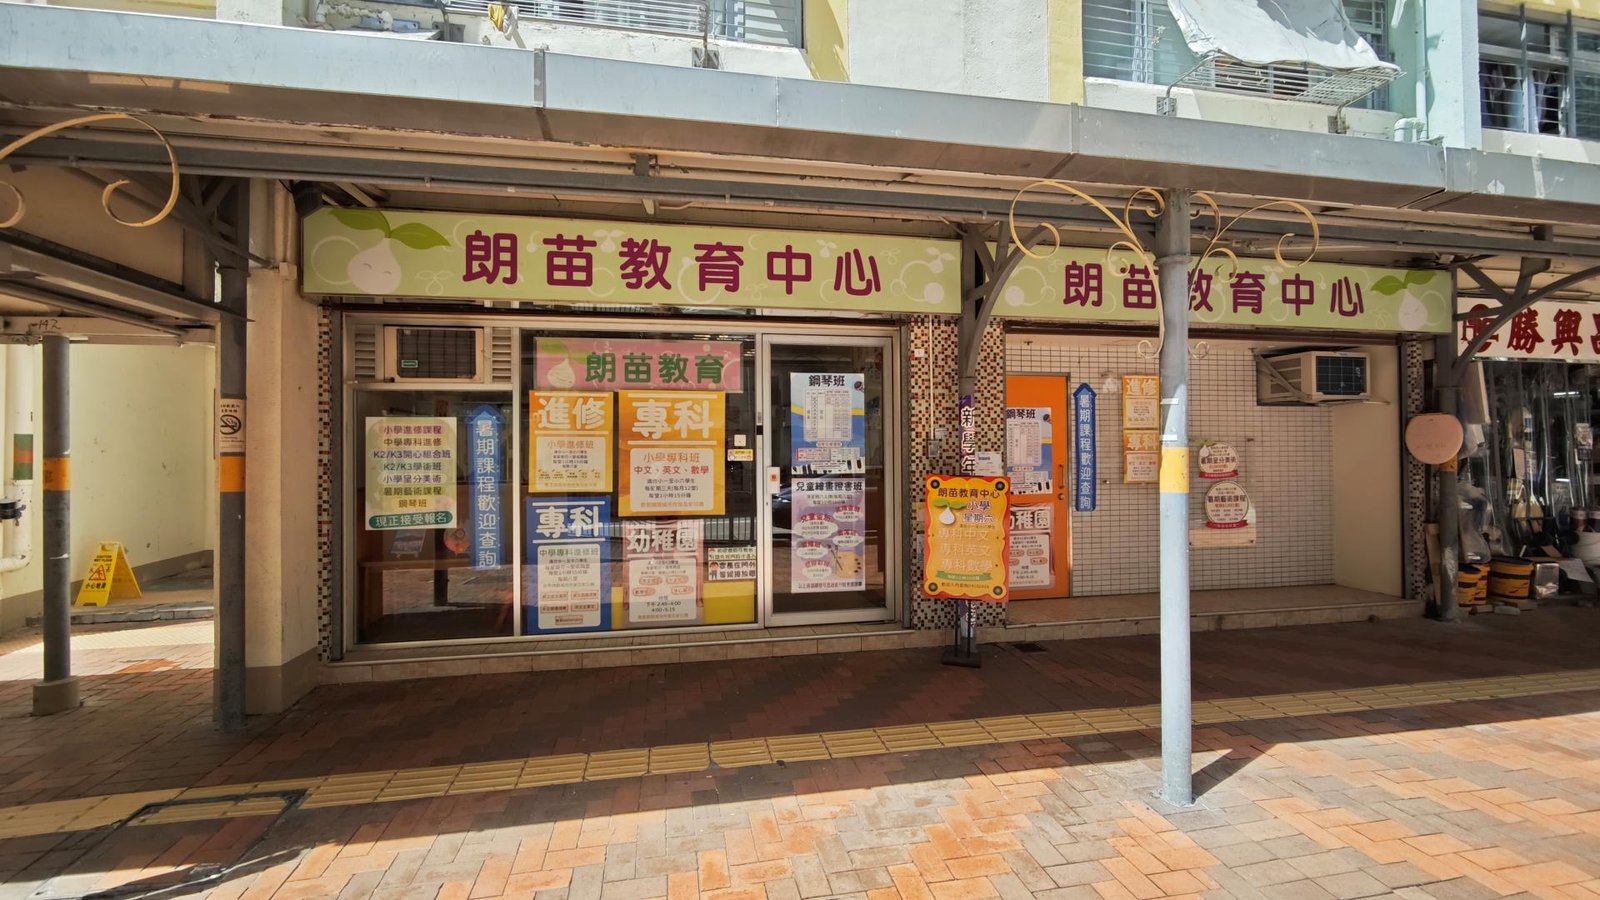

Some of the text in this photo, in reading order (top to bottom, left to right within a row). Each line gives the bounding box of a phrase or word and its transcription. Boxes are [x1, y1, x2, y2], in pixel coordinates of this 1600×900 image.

[462, 229, 881, 297] 朗苗教育中心
[1063, 260, 1365, 317] 朗苗教育中心
[1460, 303, 1600, 356] 勝興
[585, 351, 724, 384] 朗苗教育
[808, 374, 846, 387] 鋼琴班
[1126, 378, 1157, 396] 進修
[534, 396, 606, 430] 進修
[631, 399, 715, 440] 專科
[1006, 408, 1036, 419] 鋼琴班
[383, 425, 442, 435] 小學進修課程
[384, 437, 442, 447] 中學專科進修
[1127, 433, 1157, 451] 專科
[373, 449, 451, 459] K2/K3開心組合班
[643, 452, 700, 464] 小學專科班
[1079, 394, 1092, 510] 暑期課程歡迎查詢
[384, 486, 442, 496] 暑期藝術課程
[475, 419, 497, 569] 暑期課程歡迎查詢
[796, 481, 863, 492] 兒童繪畫證書班
[938, 487, 1001, 499] 朗苗教育中心
[398, 499, 427, 508] 鋼琴班
[967, 500, 991, 511] 小學
[375, 512, 448, 528] 現正接受報名
[535, 505, 604, 539] 專科
[963, 513, 995, 523] 星期六
[627, 529, 697, 553] 幼稚園
